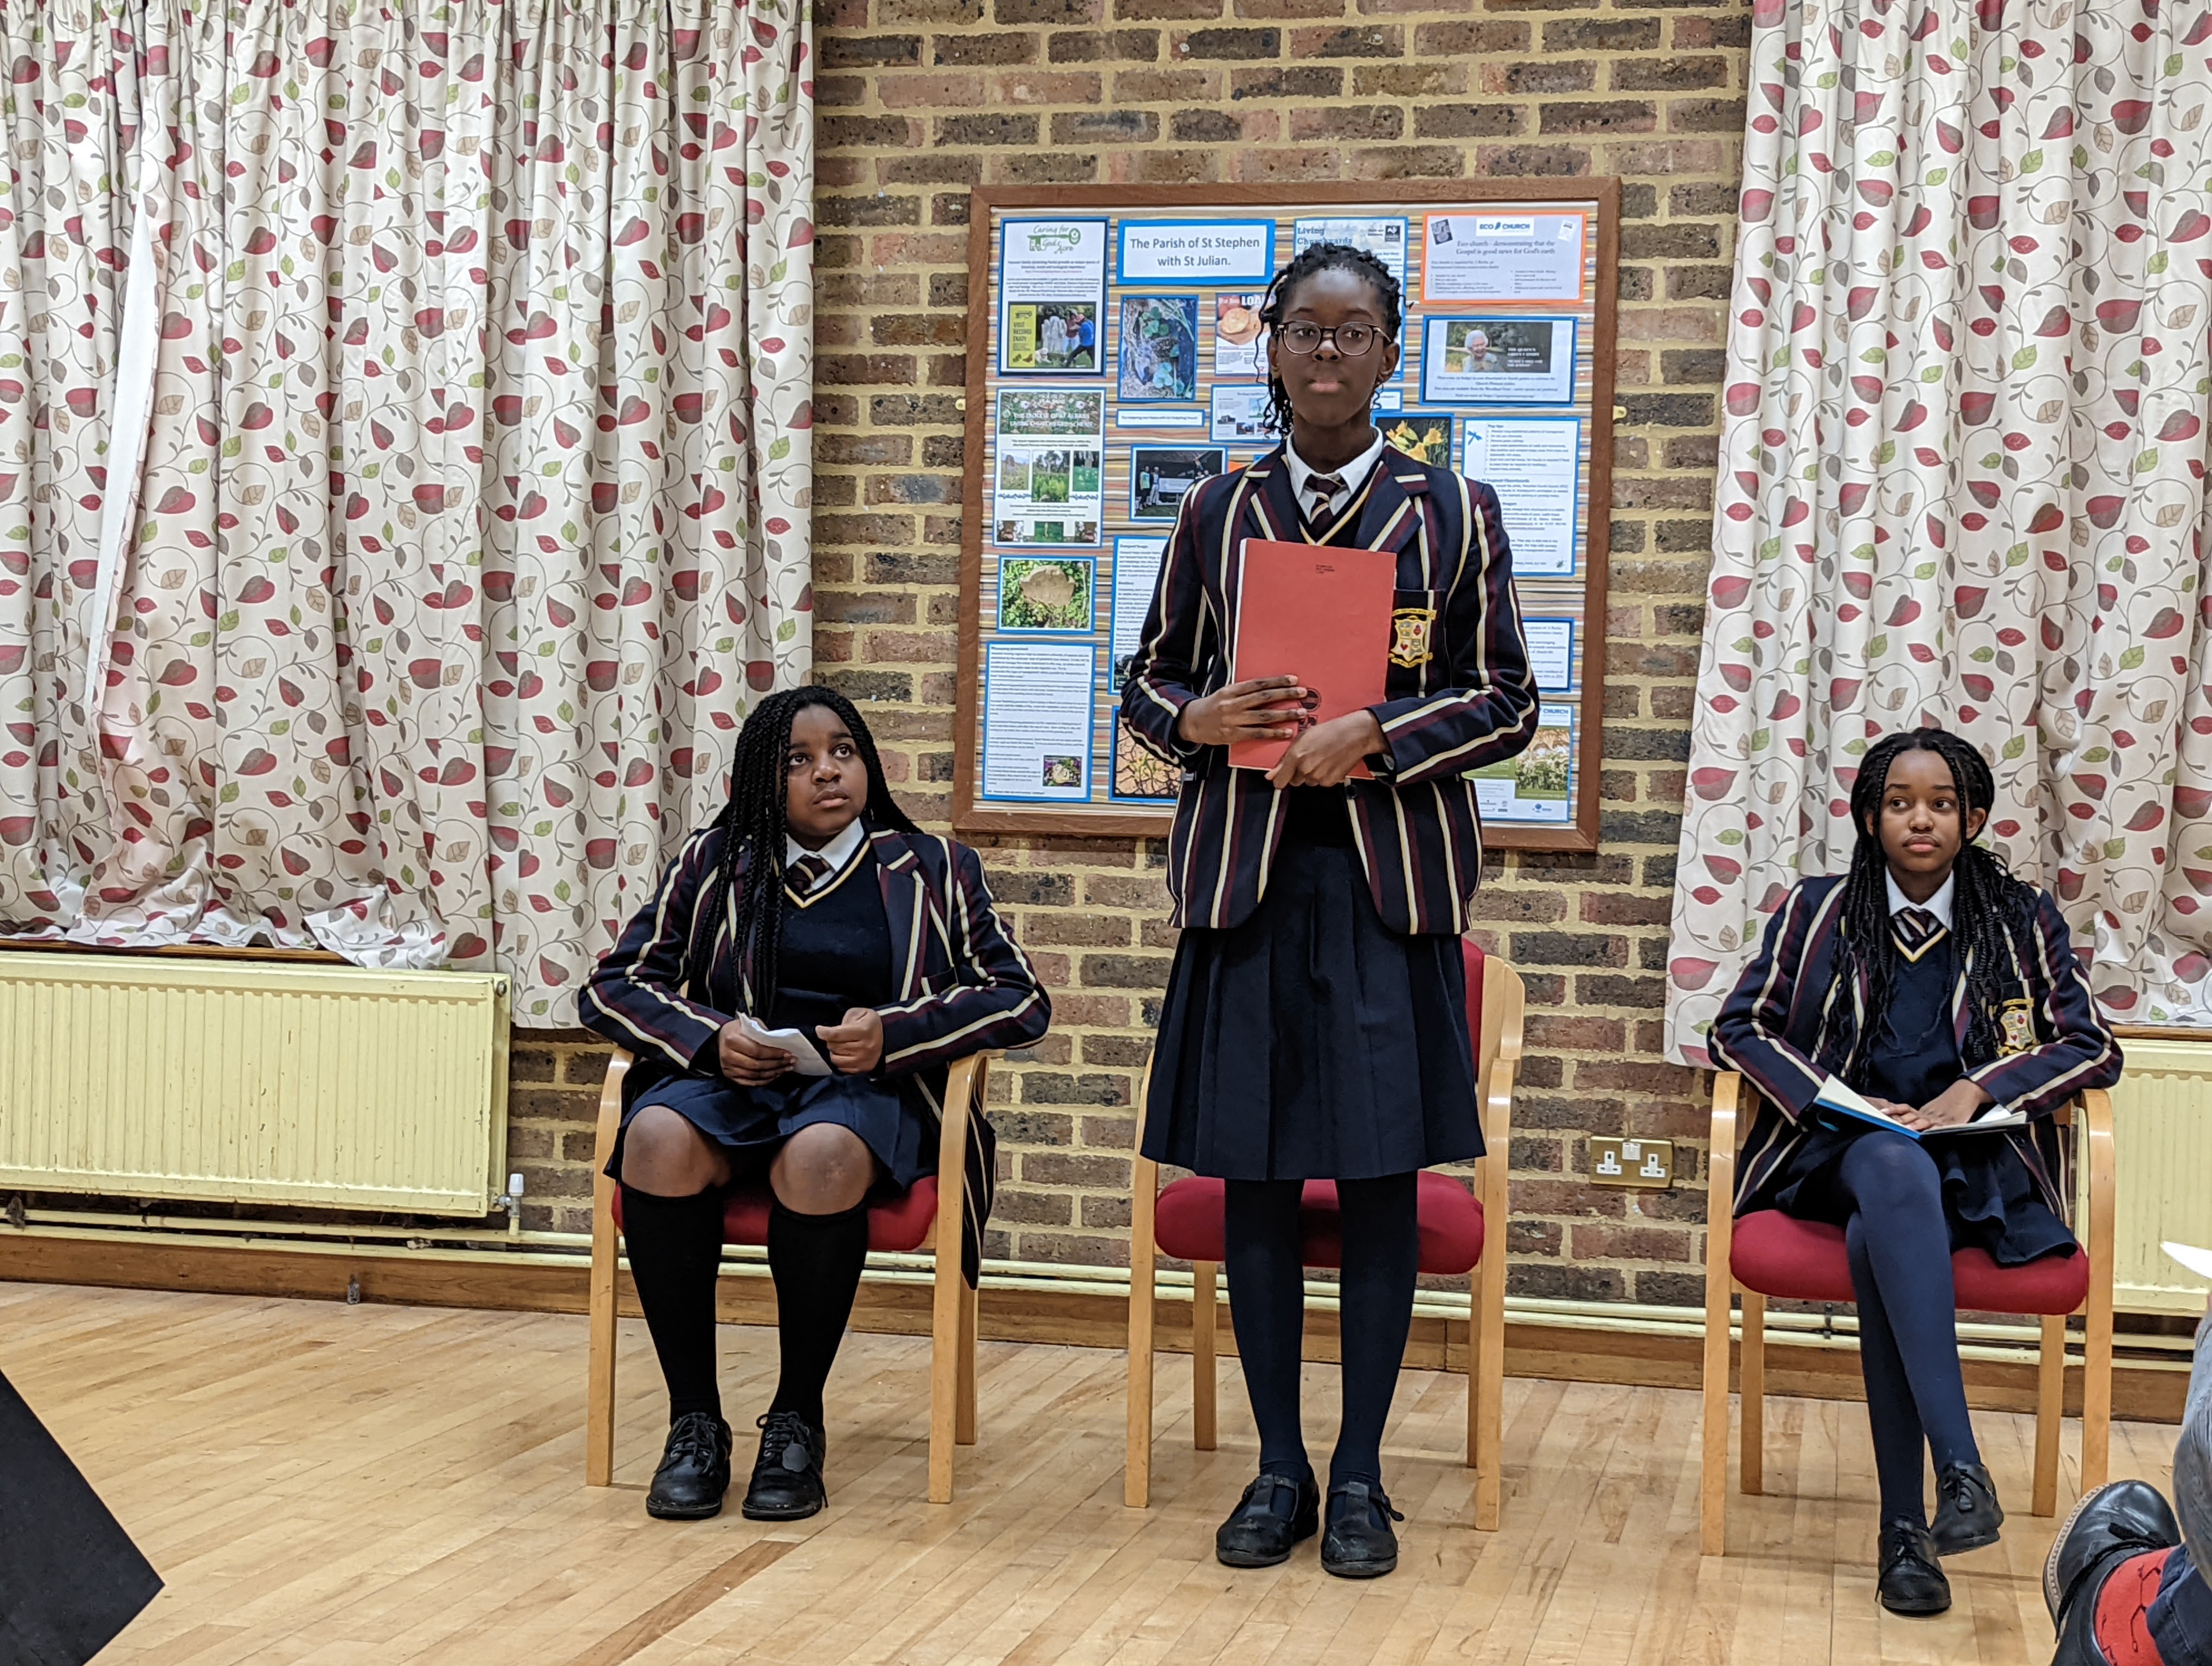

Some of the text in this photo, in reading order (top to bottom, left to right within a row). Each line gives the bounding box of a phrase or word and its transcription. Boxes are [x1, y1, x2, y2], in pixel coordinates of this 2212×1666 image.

[1297, 227, 1324, 235] Living
[1130, 237, 1259, 249] The Parish of St Stephen
[1158, 255, 1231, 266] with St Julian.
